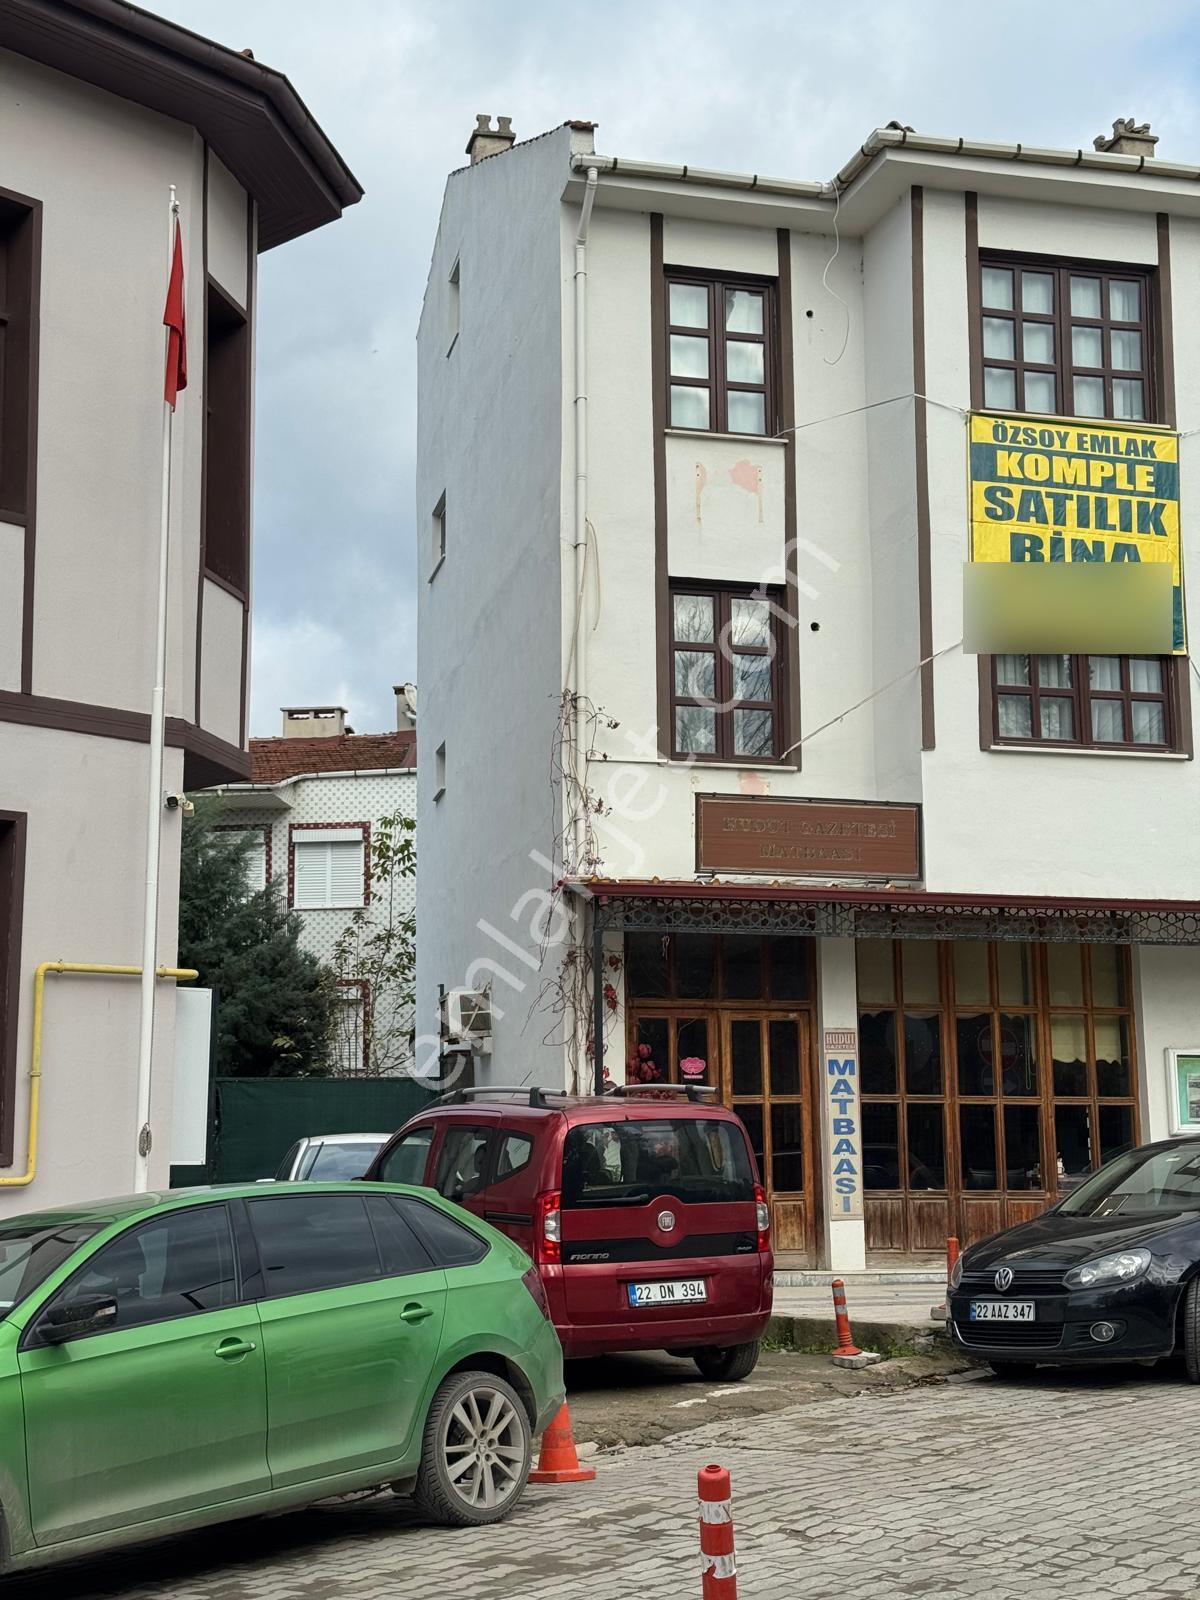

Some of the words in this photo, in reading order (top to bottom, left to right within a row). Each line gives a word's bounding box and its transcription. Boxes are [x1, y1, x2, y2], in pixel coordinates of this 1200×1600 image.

[992, 420, 1071, 449] ÖZSOY
[1076, 433, 1157, 459] EMLAK
[996, 450, 1156, 493] KOMPLE
[983, 485, 1168, 537] SATILIK
[828, 1059, 858, 1213] MATBAASI
[637, 1286, 652, 1300] 22
[659, 1284, 675, 1298] DN
[681, 1282, 704, 1297] 394
[977, 1305, 988, 1318] 22
[991, 1305, 1009, 1318] AAZ
[1013, 1305, 1032, 1318] 347
